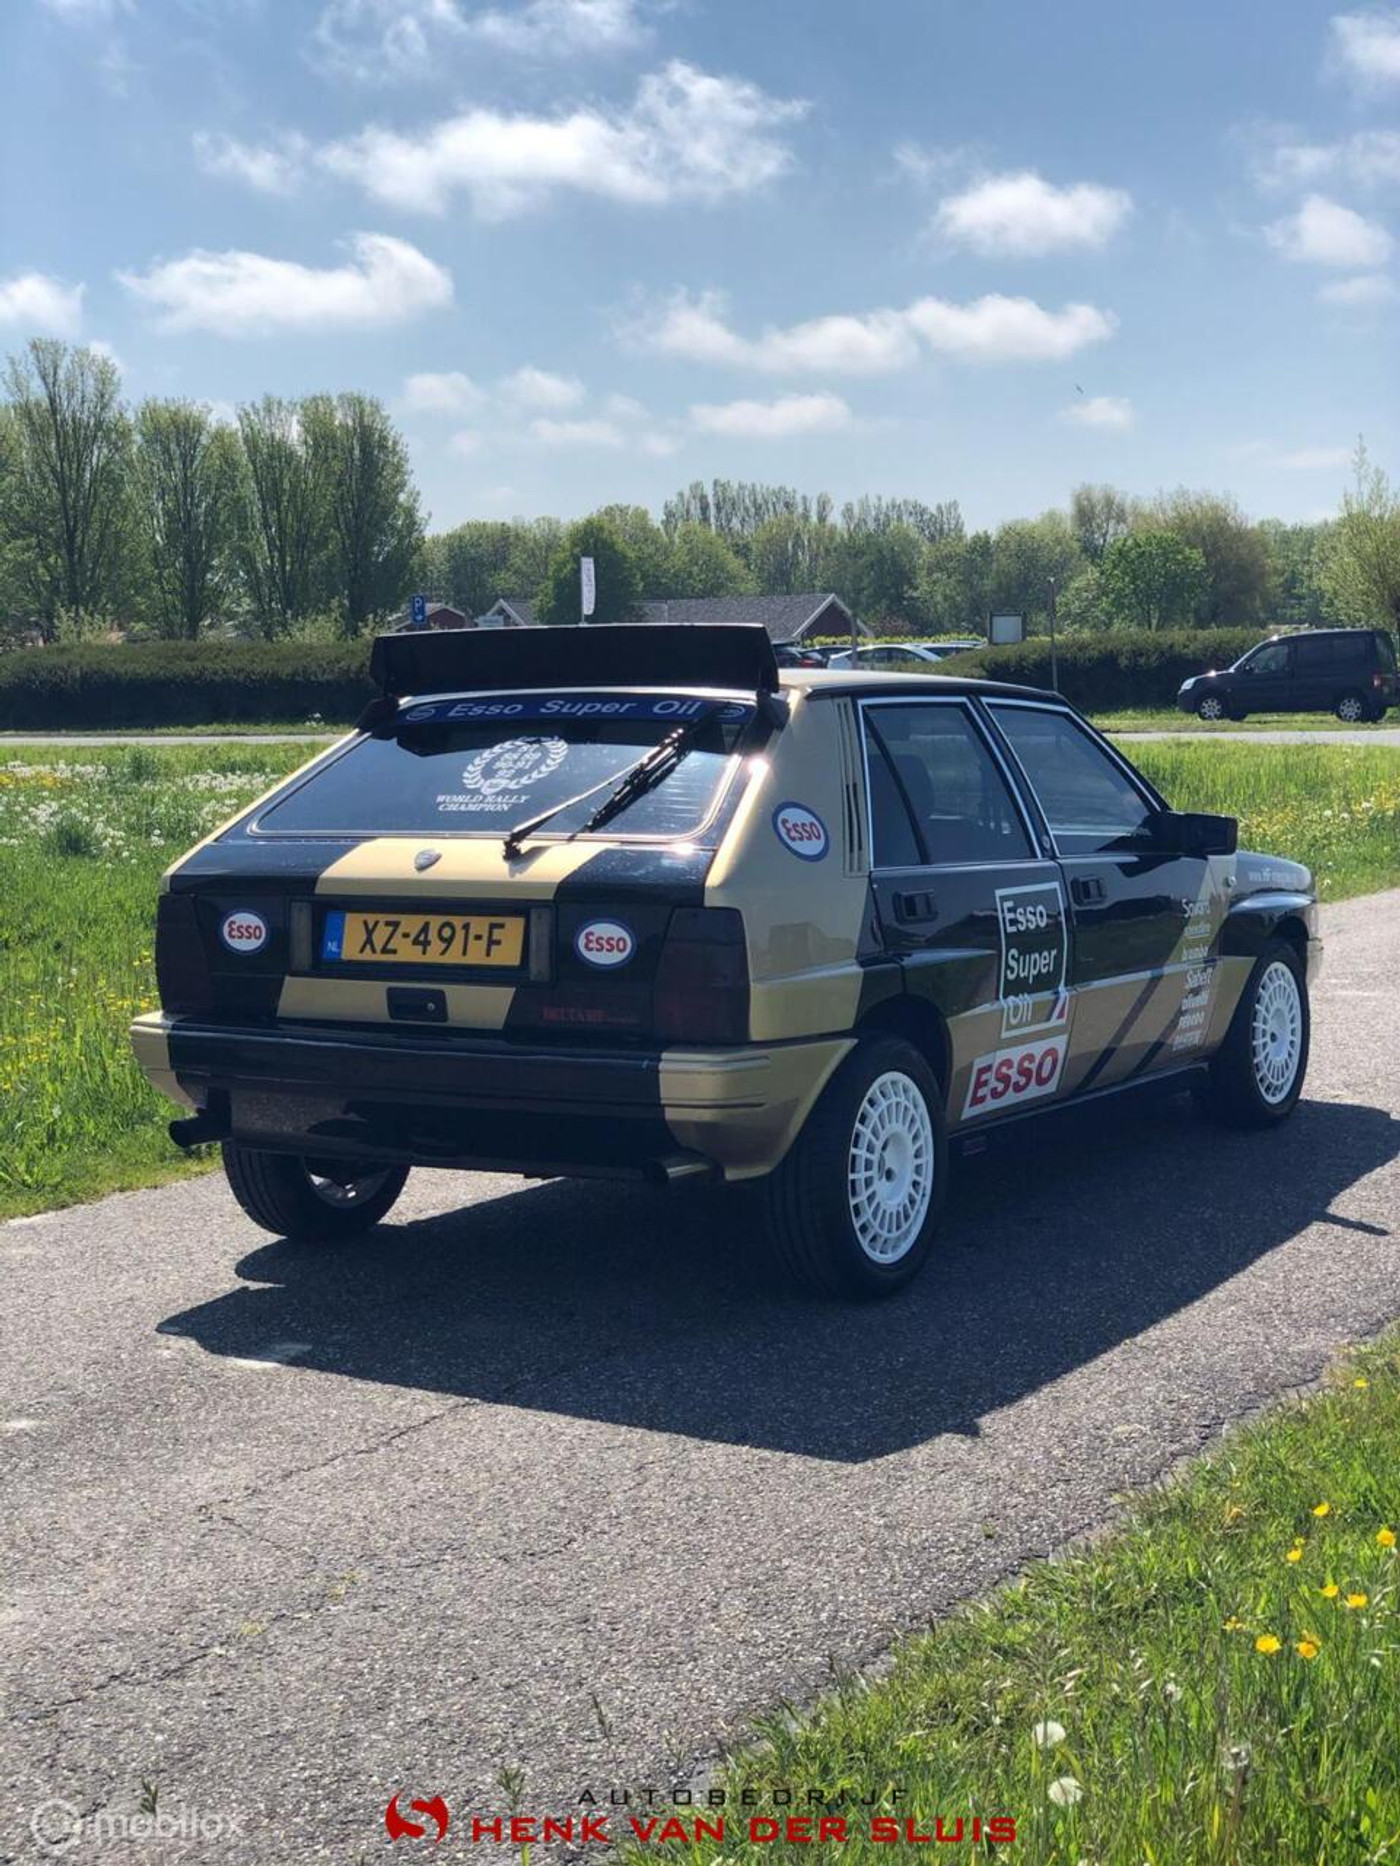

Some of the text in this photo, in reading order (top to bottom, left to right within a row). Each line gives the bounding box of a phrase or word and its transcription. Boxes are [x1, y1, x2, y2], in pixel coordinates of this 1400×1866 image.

[415, 597, 423, 613] P
[447, 703, 524, 717] Esso
[539, 700, 637, 717] Super
[652, 700, 702, 715] Oil
[436, 794, 532, 804] WORLD RALLY
[438, 803, 512, 812] CHAMPION
[1003, 900, 1047, 933] Esso
[327, 940, 341, 953] NL
[358, 919, 506, 958] XZ-491-F
[1006, 946, 1058, 984] Super
[1006, 992, 1032, 1025] Oil
[968, 1046, 1060, 1109] ESSO
